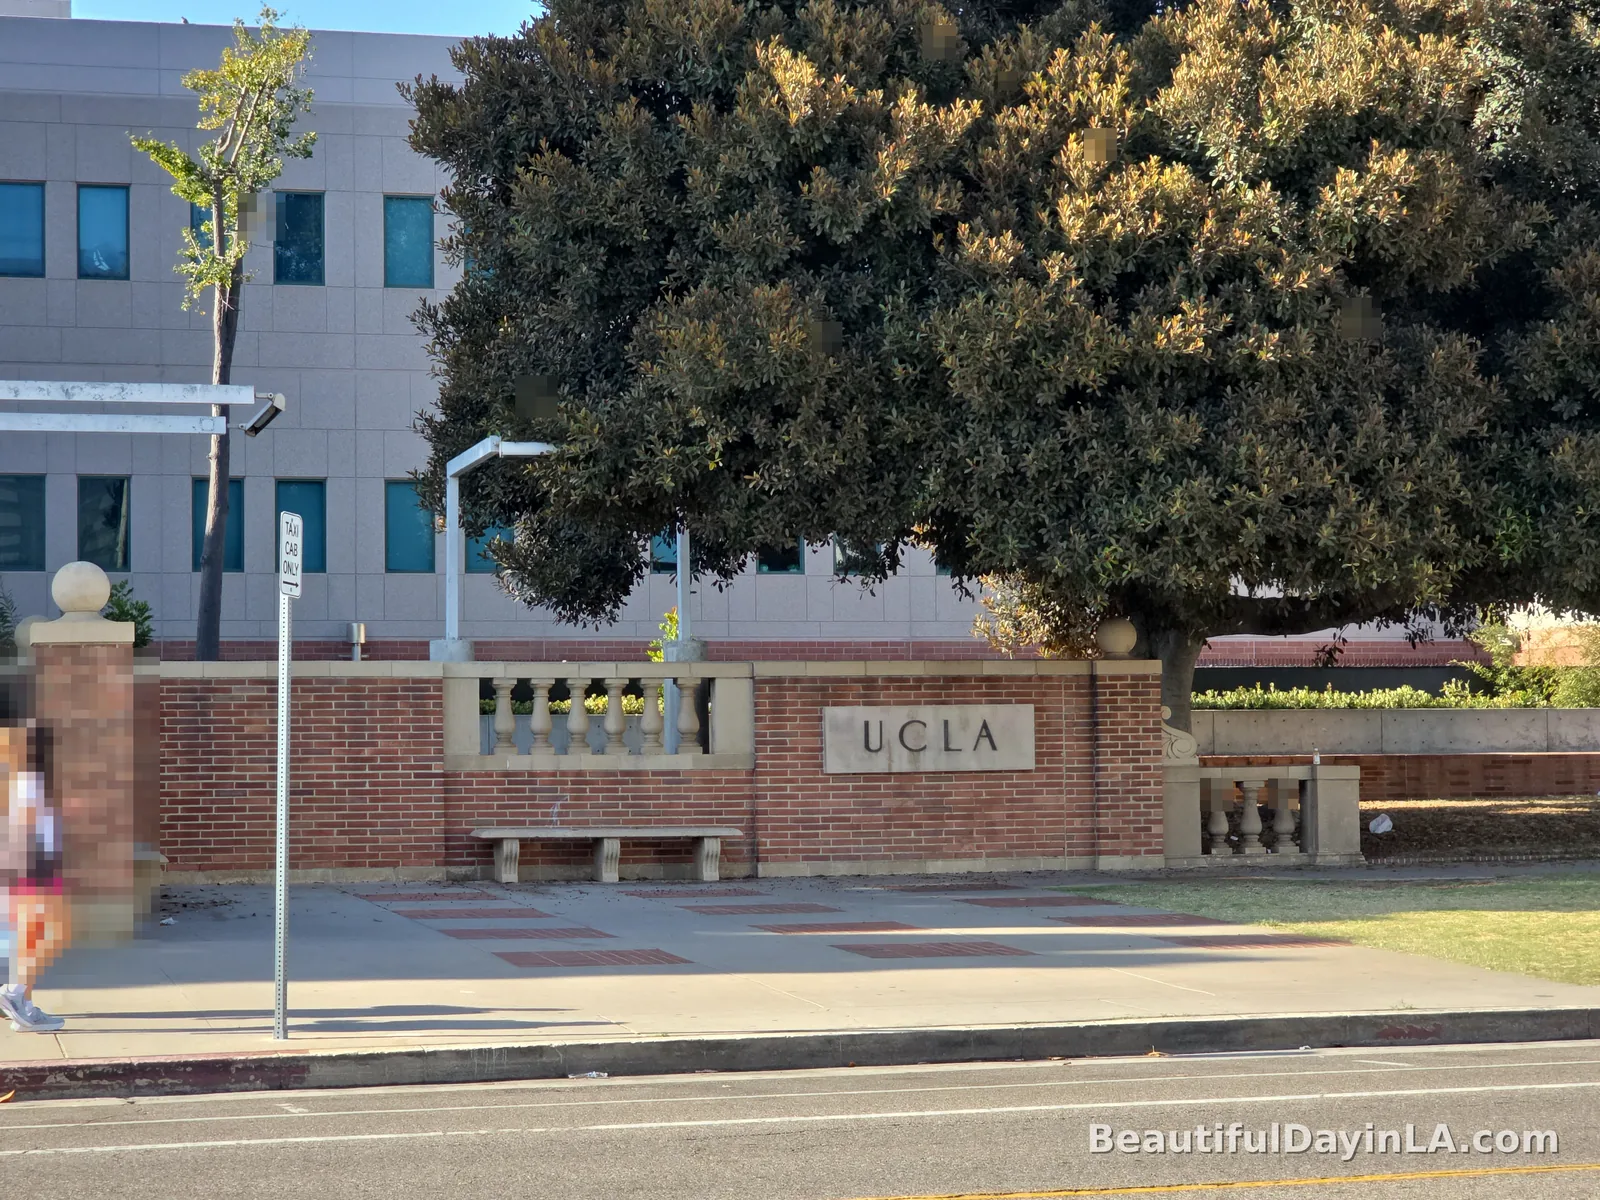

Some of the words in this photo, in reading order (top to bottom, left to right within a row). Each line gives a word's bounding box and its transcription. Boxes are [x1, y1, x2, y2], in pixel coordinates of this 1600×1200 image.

[285, 521, 299, 538] TAXI
[285, 541, 298, 557] CAB
[283, 560, 299, 576] ONLY
[864, 719, 998, 753] UCLA
